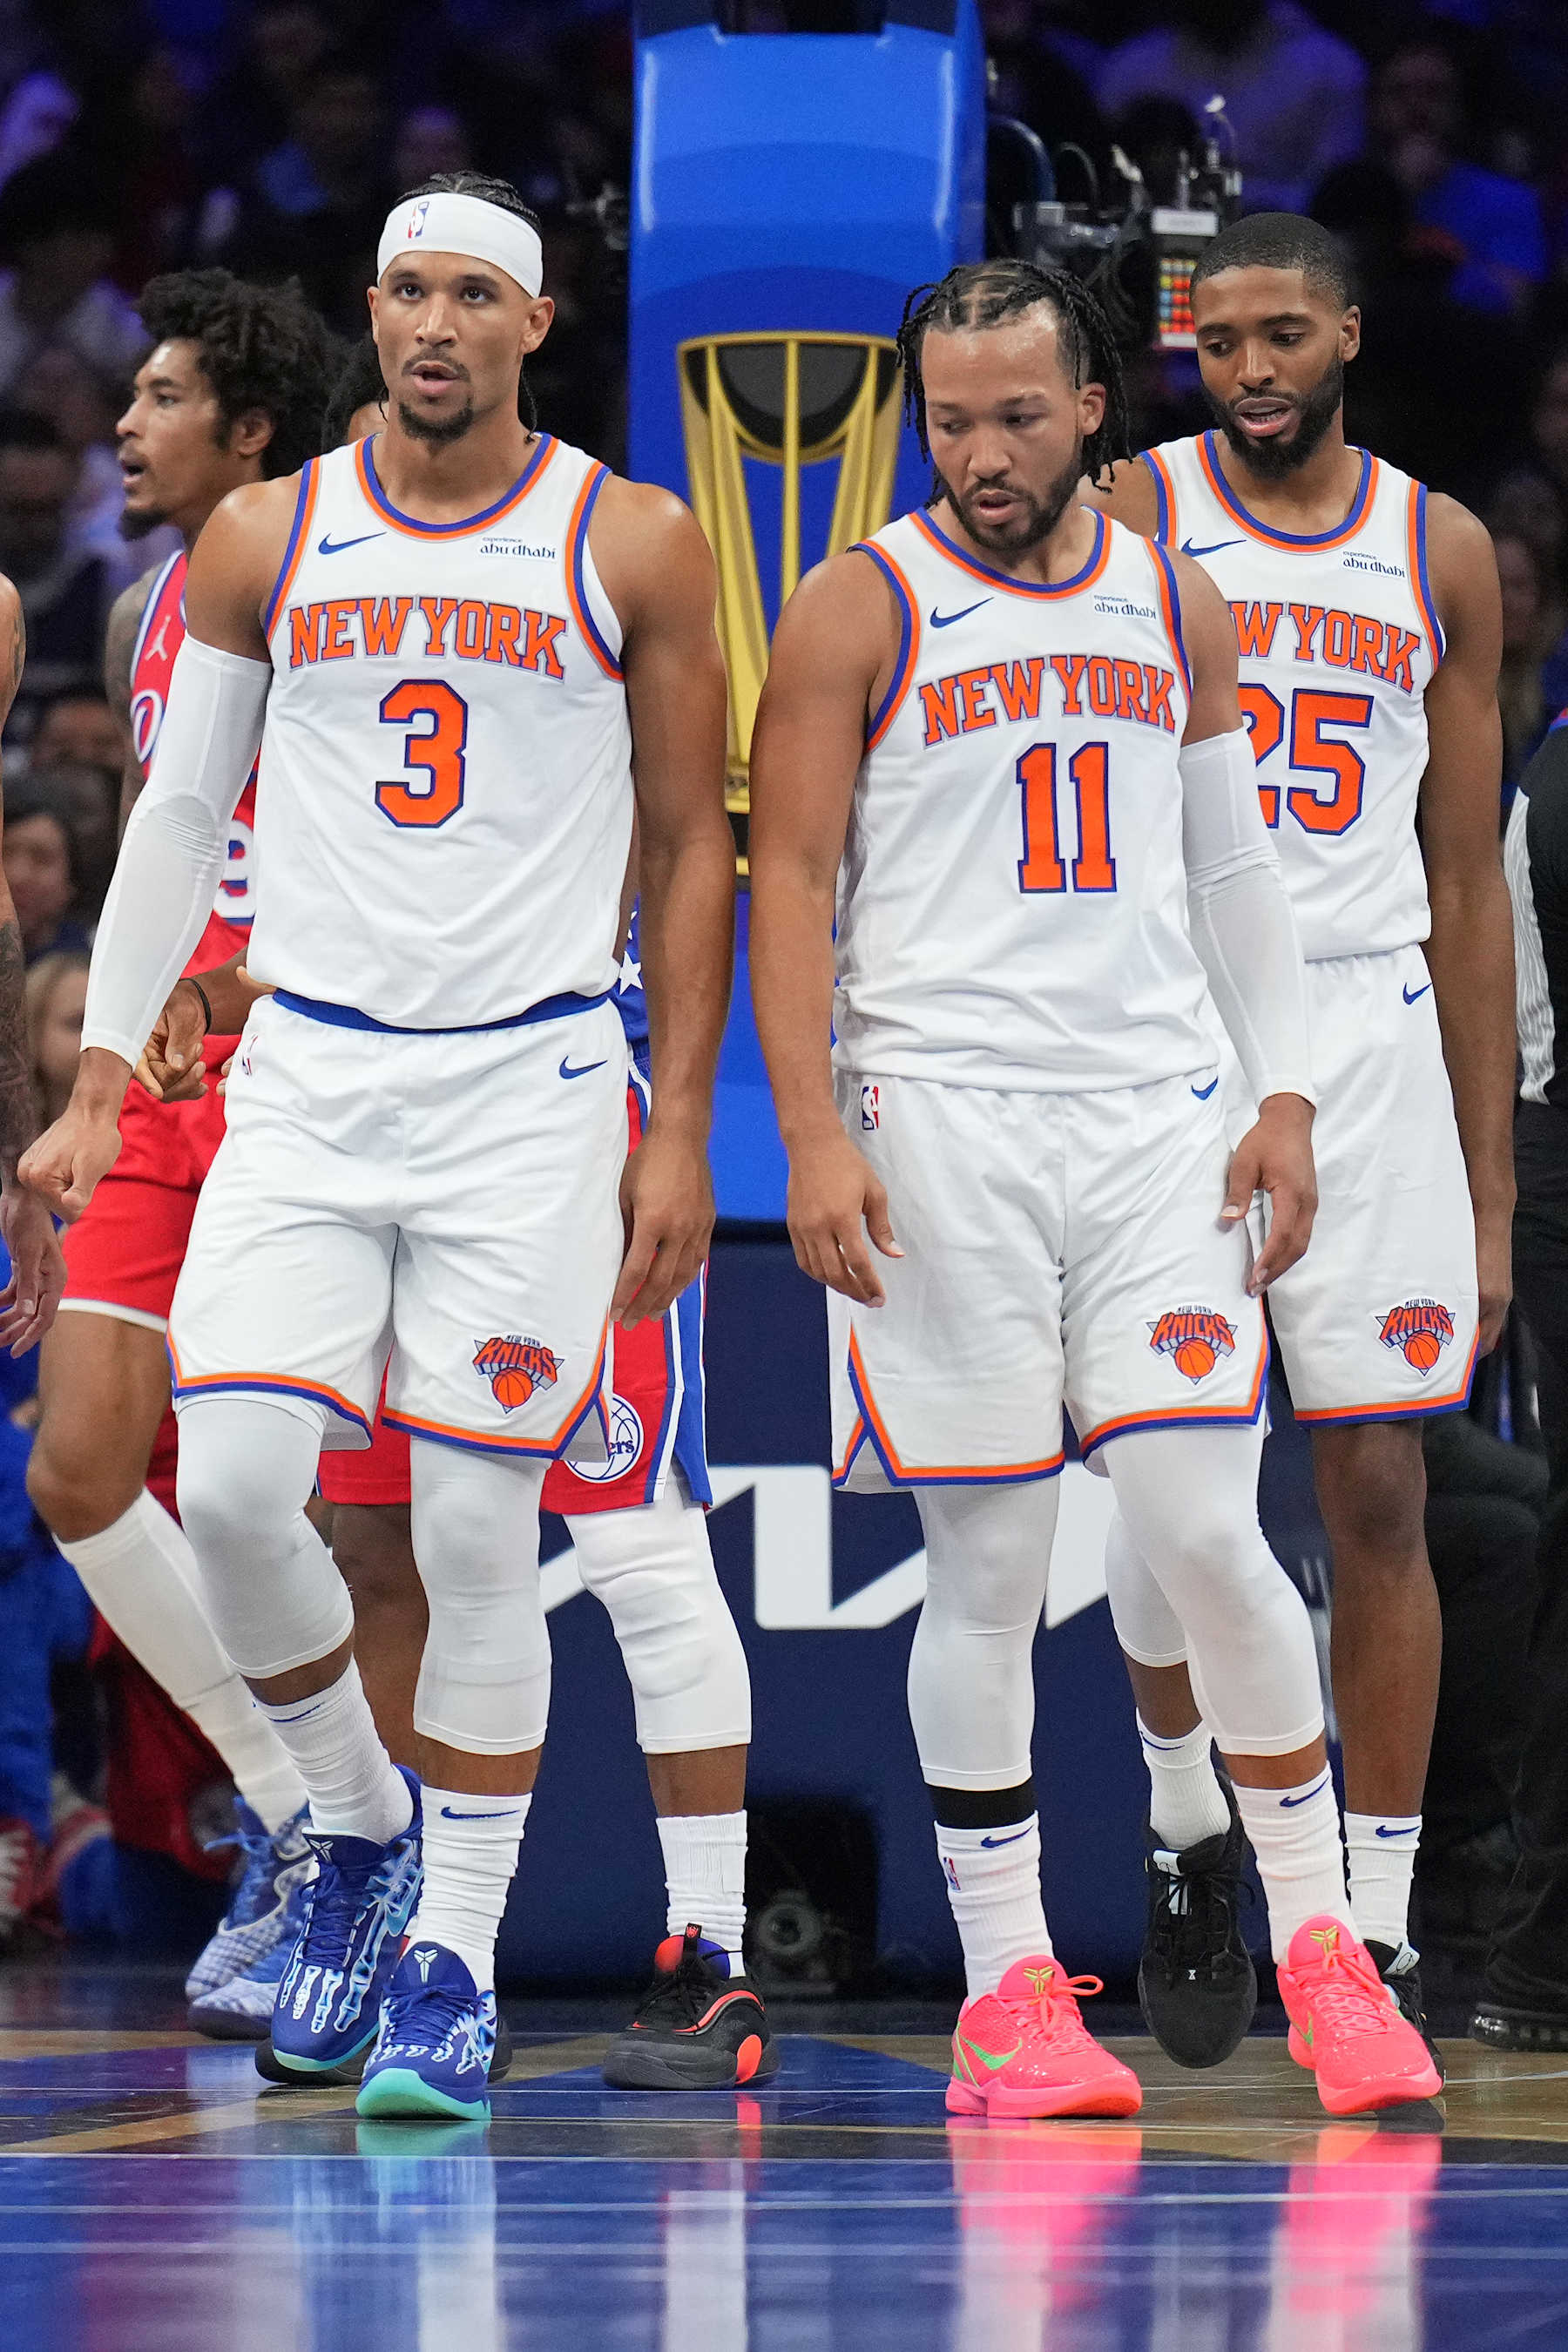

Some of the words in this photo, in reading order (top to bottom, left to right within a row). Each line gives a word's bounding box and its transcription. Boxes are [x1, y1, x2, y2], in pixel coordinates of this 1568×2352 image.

[480, 543, 509, 554] abu
[512, 544, 557, 559] dhabi
[1343, 558, 1368, 570] abu
[1369, 561, 1405, 578] dhabi
[1094, 602, 1119, 614] abu
[1121, 604, 1157, 619] dhabi
[288, 597, 414, 672] NEW
[418, 597, 567, 683] YORK
[1287, 601, 1422, 696] YORK
[919, 656, 1045, 749] NEW
[1047, 654, 1177, 735] YORK
[375, 679, 469, 828] 3
[1237, 682, 1375, 836] 25
[1016, 741, 1118, 894] 11
[1150, 1312, 1235, 1350] KNICKS
[1380, 1304, 1454, 1342] KNICKS
[472, 1337, 558, 1383] KNICKS
[609, 1440, 635, 1456] ers
